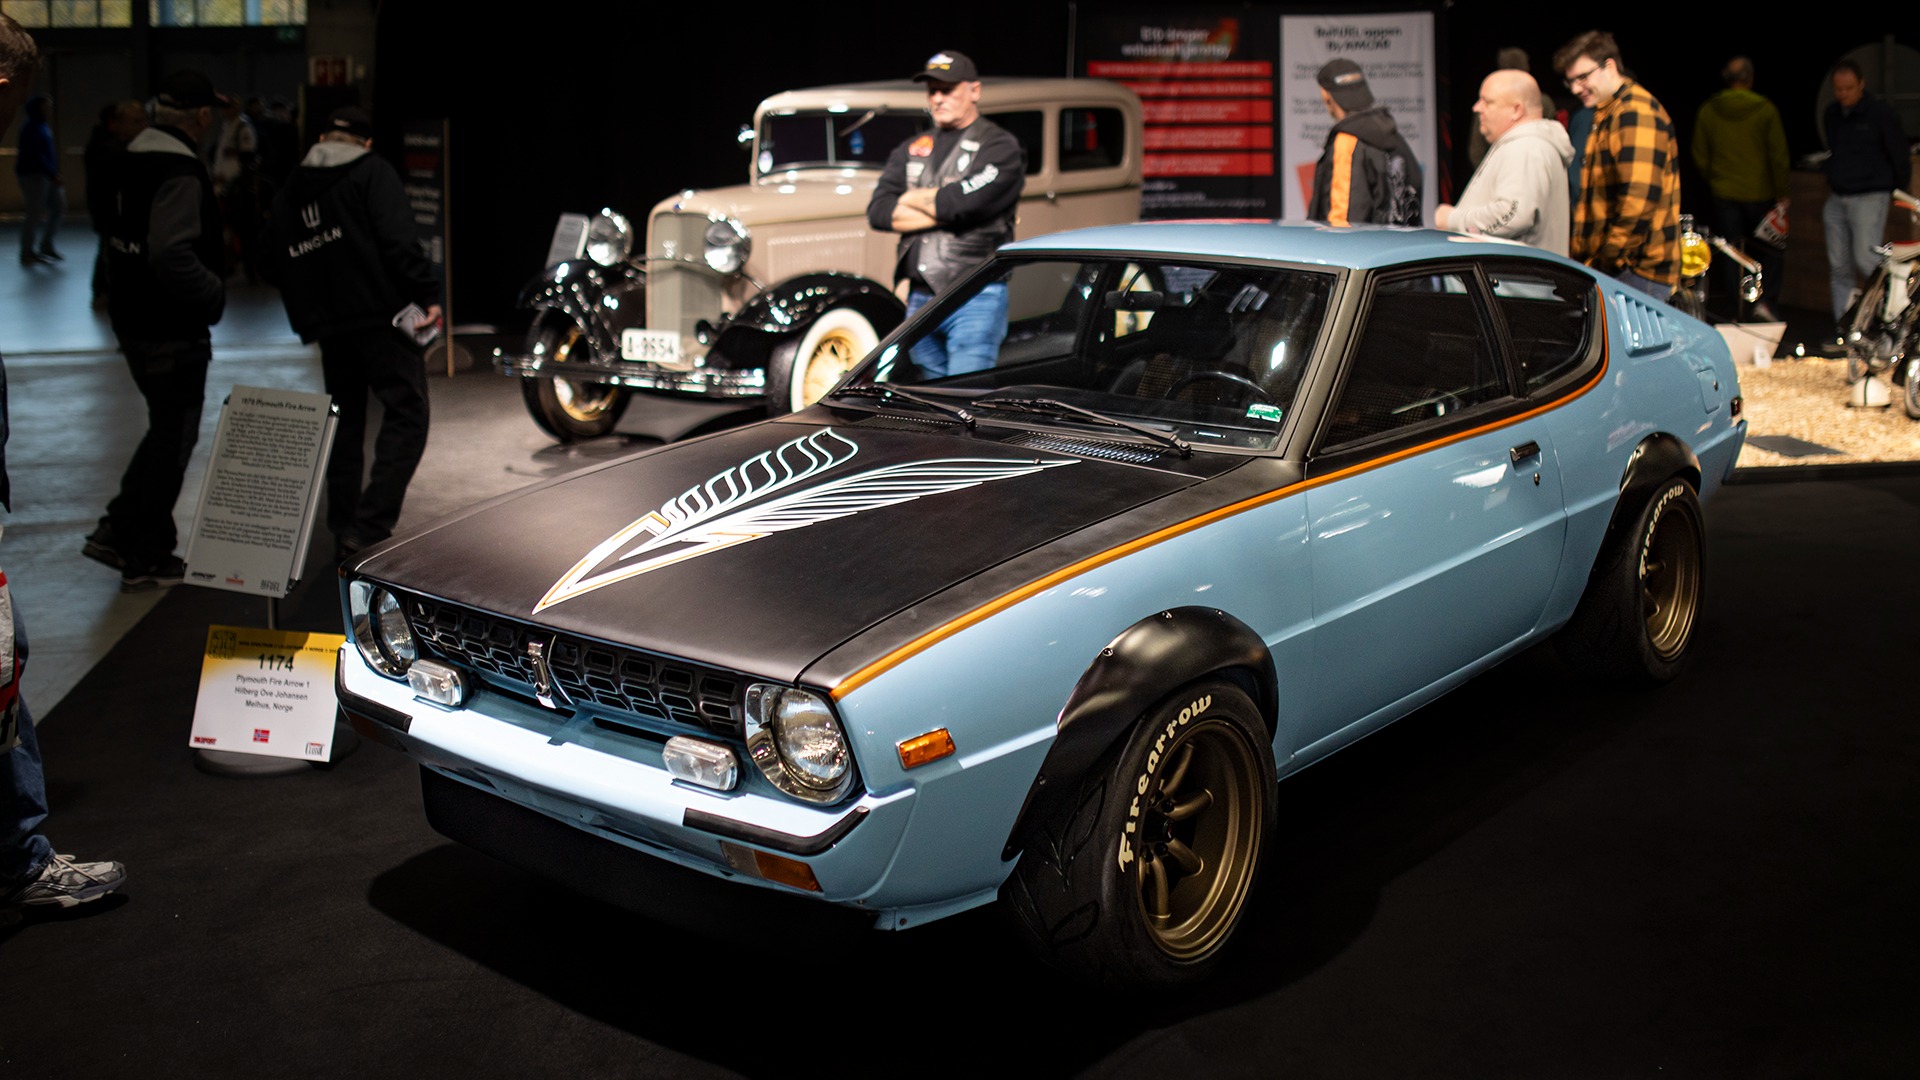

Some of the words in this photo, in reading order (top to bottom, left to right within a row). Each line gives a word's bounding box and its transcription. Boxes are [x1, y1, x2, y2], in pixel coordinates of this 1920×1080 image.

[258, 653, 294, 672] 1174
[236, 673, 268, 685] Plymouth
[269, 677, 283, 686] Fire
[284, 679, 304, 688] Arrow
[260, 688, 274, 697] Ove
[274, 690, 308, 700] Johansen
[273, 701, 294, 713] Norge
[1117, 693, 1213, 874] Firearrow
